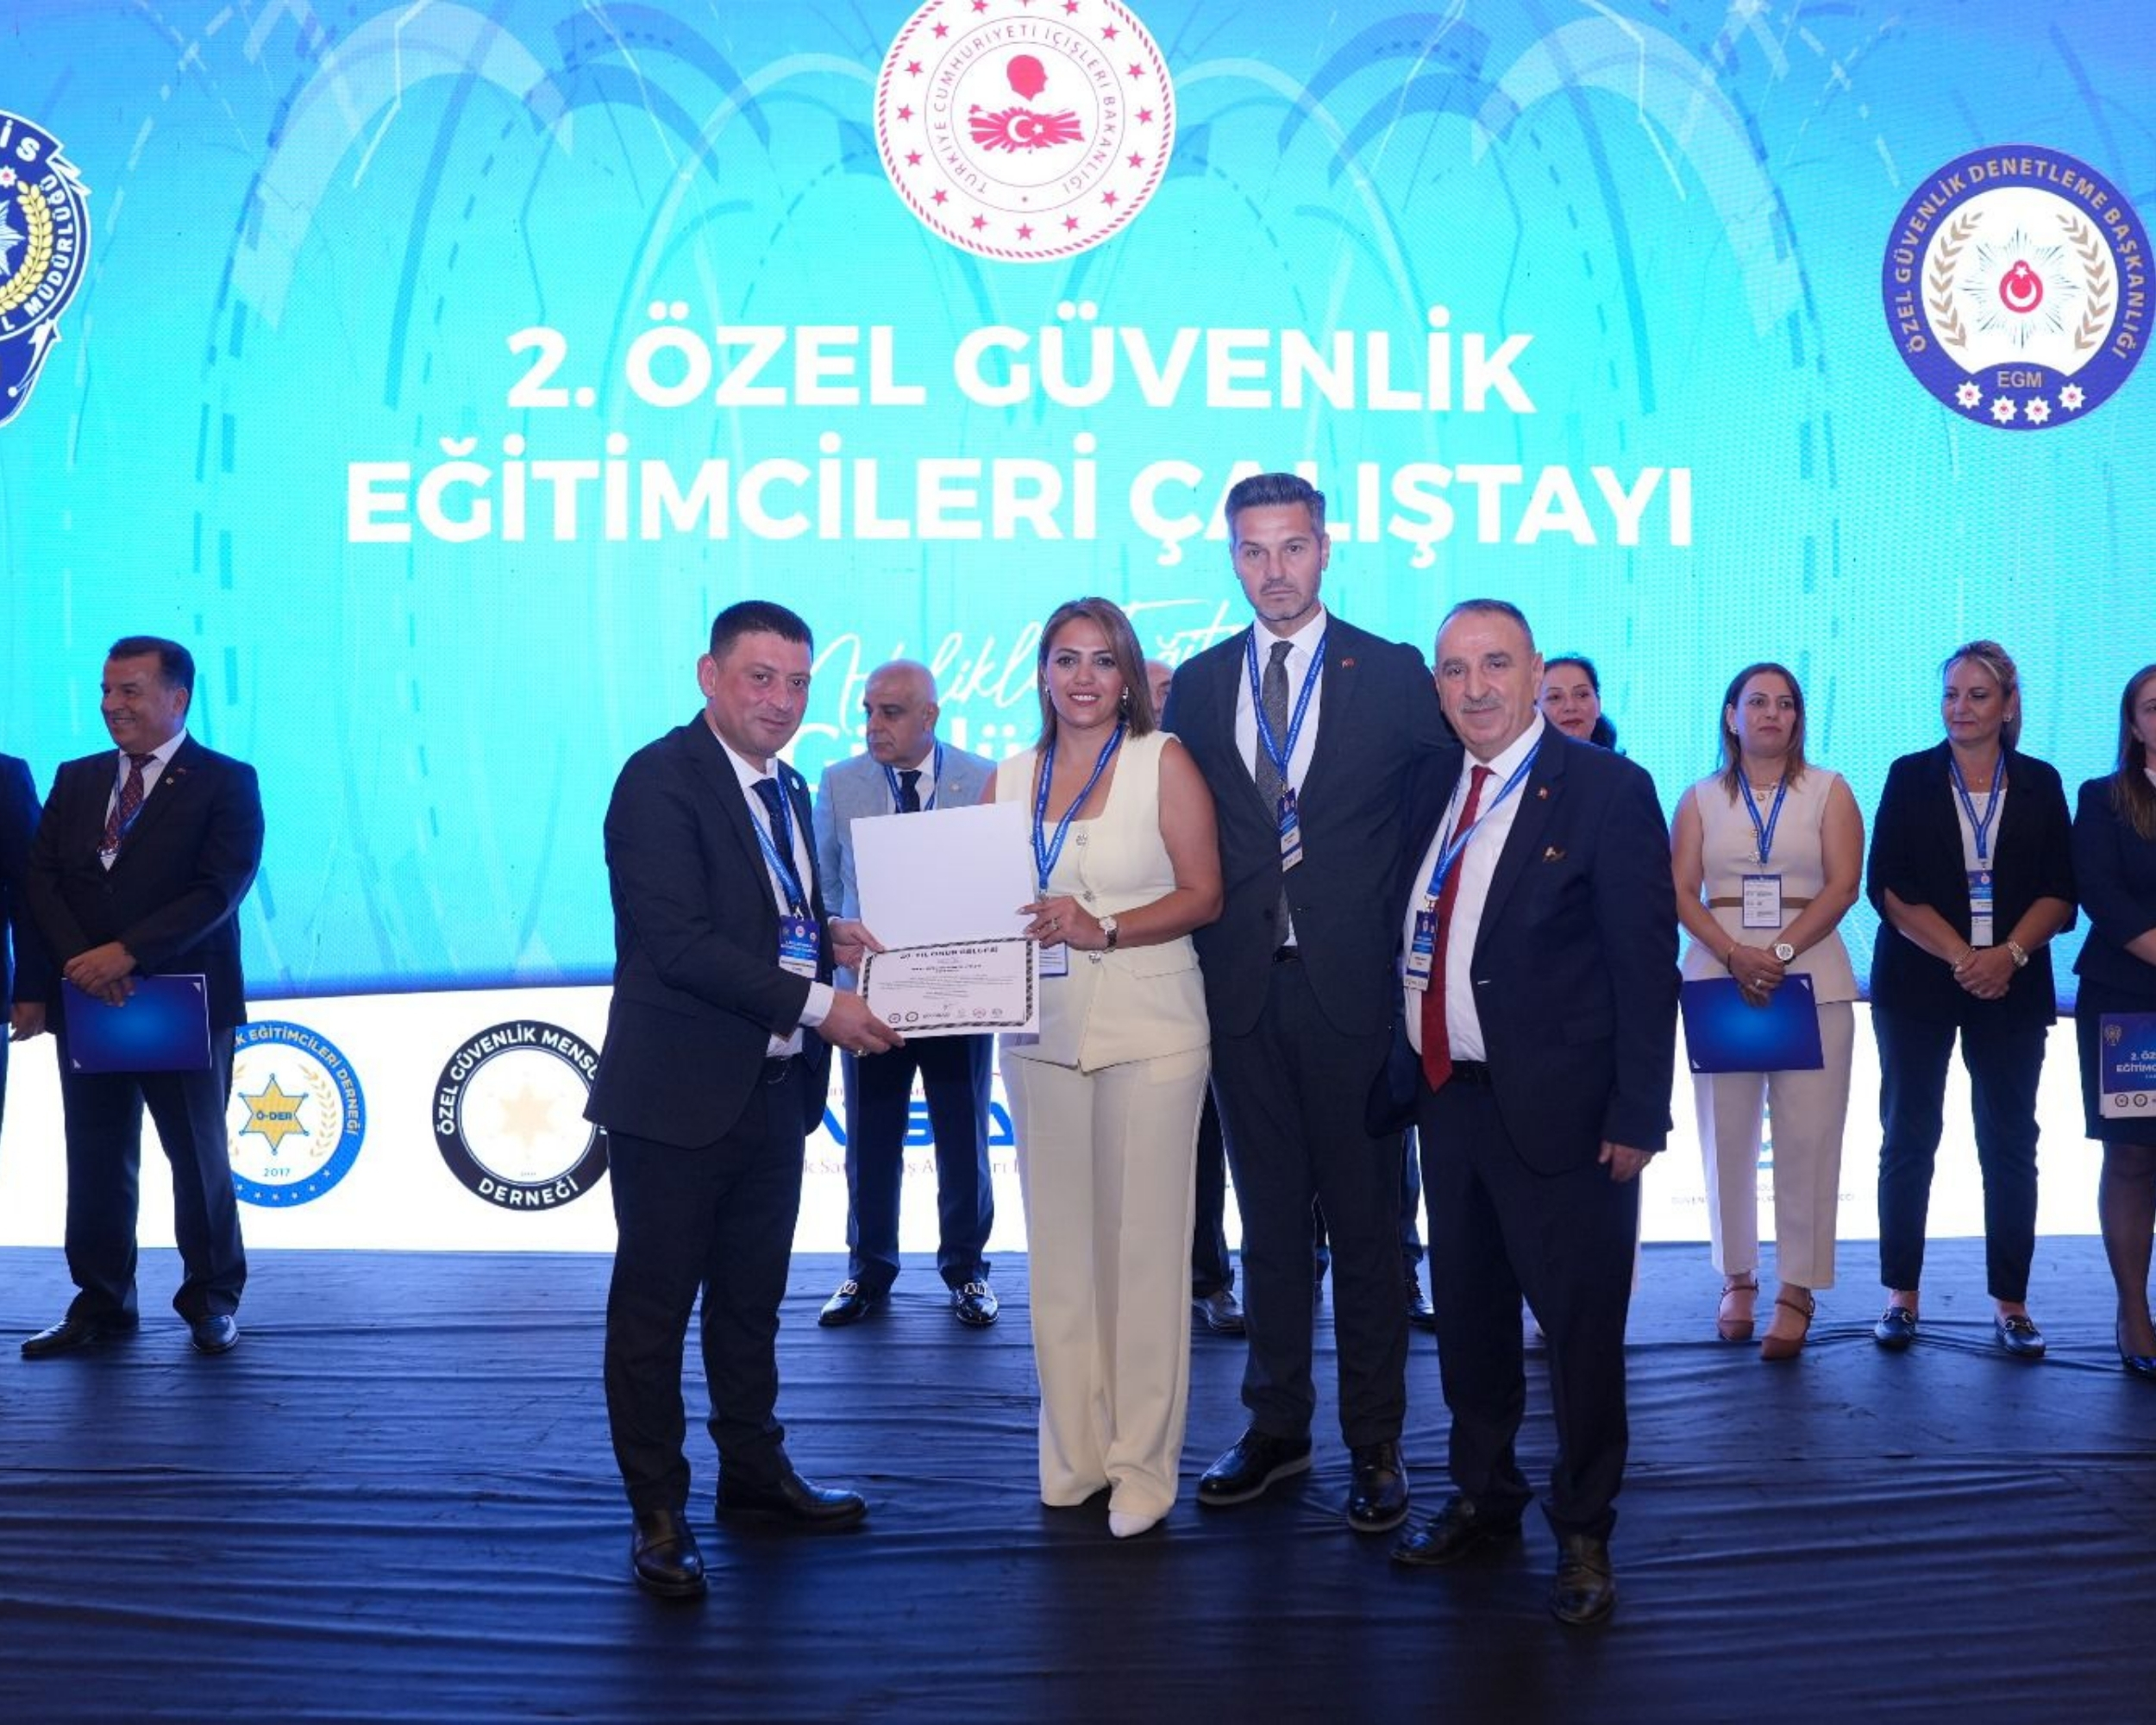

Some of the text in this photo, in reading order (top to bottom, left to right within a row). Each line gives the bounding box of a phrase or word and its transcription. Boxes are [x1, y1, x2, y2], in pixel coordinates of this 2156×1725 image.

[23, 173, 74, 318] MÜDÜRLÜĞÜ
[1894, 157, 2145, 359] ÖZEL GÜVENLİK DENETLEME BAŞKANLIĞI
[509, 301, 1534, 412] 2. ÖZEL GÜVENLİK
[1996, 370, 2042, 388] EGM
[348, 431, 1096, 543] EĞİTİMCİLERİ
[248, 1025, 342, 1069] EĞİTİMCİLERİ
[436, 1085, 460, 1135] ÖZEL
[449, 1023, 536, 1082] GÜVENLİK
[262, 1167, 291, 1178] 2017
[478, 1175, 580, 1207] DERNEĞİ
